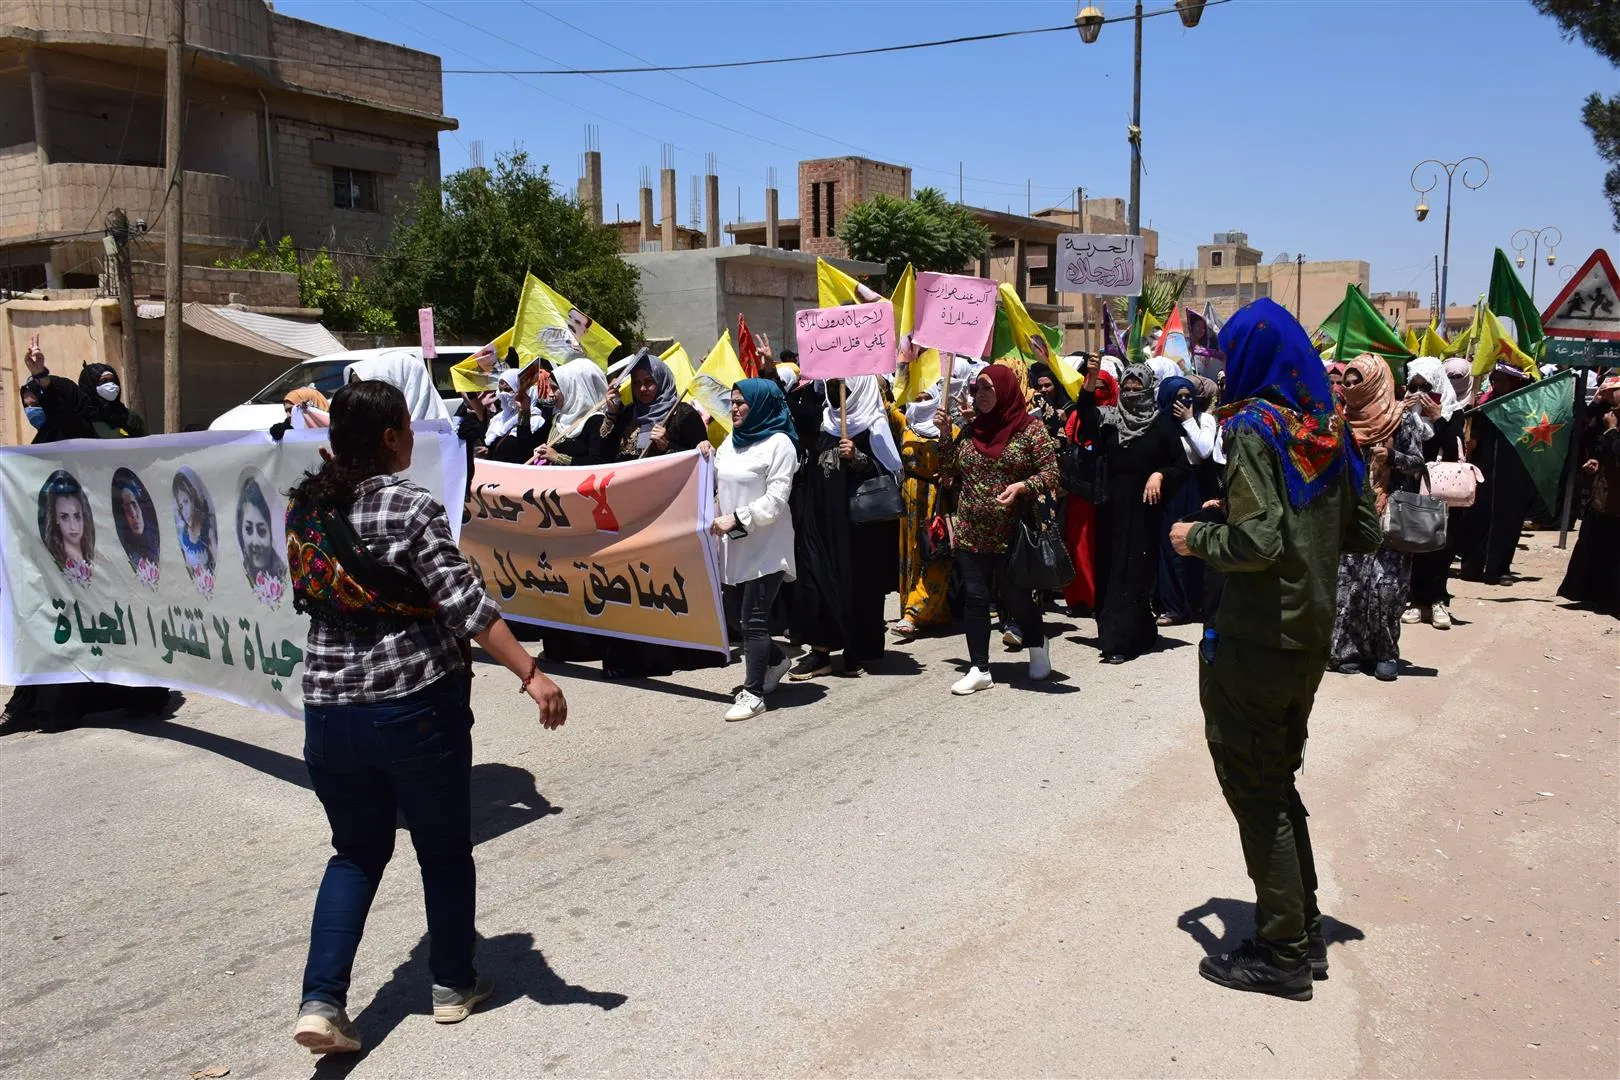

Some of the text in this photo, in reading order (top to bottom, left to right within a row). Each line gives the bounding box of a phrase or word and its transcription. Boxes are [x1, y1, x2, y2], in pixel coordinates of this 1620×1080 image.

[1064, 238, 1134, 257] الحرية
[816, 316, 846, 330] بدون
[845, 308, 874, 328] حياة
[871, 309, 884, 324] لا
[842, 336, 860, 353] قتل
[864, 328, 889, 351] يكفي
[577, 471, 620, 534] لا
[493, 548, 570, 600] شمال
[572, 560, 689, 616] لمناطق
[53, 598, 138, 656] الحياة
[147, 603, 211, 664] تقتلوا
[212, 614, 235, 666] لا
